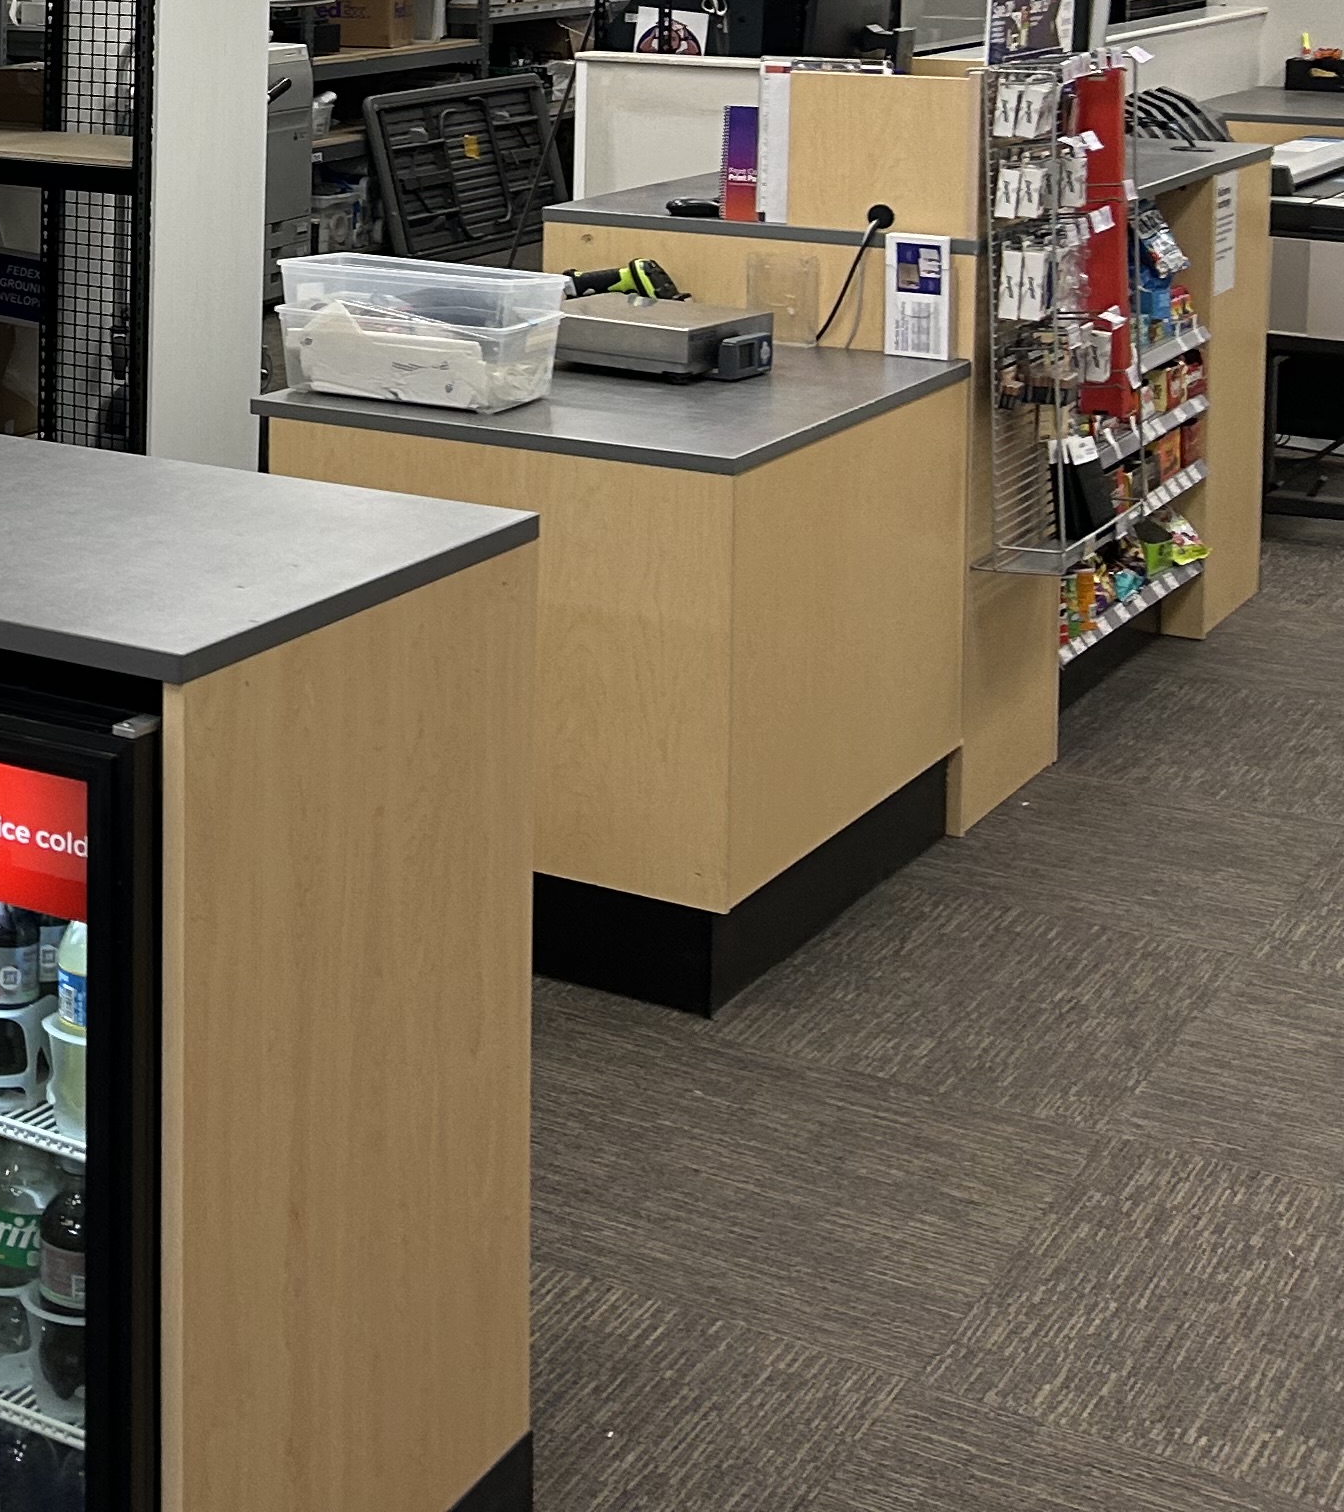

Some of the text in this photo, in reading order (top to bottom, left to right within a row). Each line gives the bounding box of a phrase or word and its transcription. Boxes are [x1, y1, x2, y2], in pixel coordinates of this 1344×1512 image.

[316, 1, 370, 19] edEx
[0, 277, 40, 293] GROUN
[36, 831, 88, 858] cold
